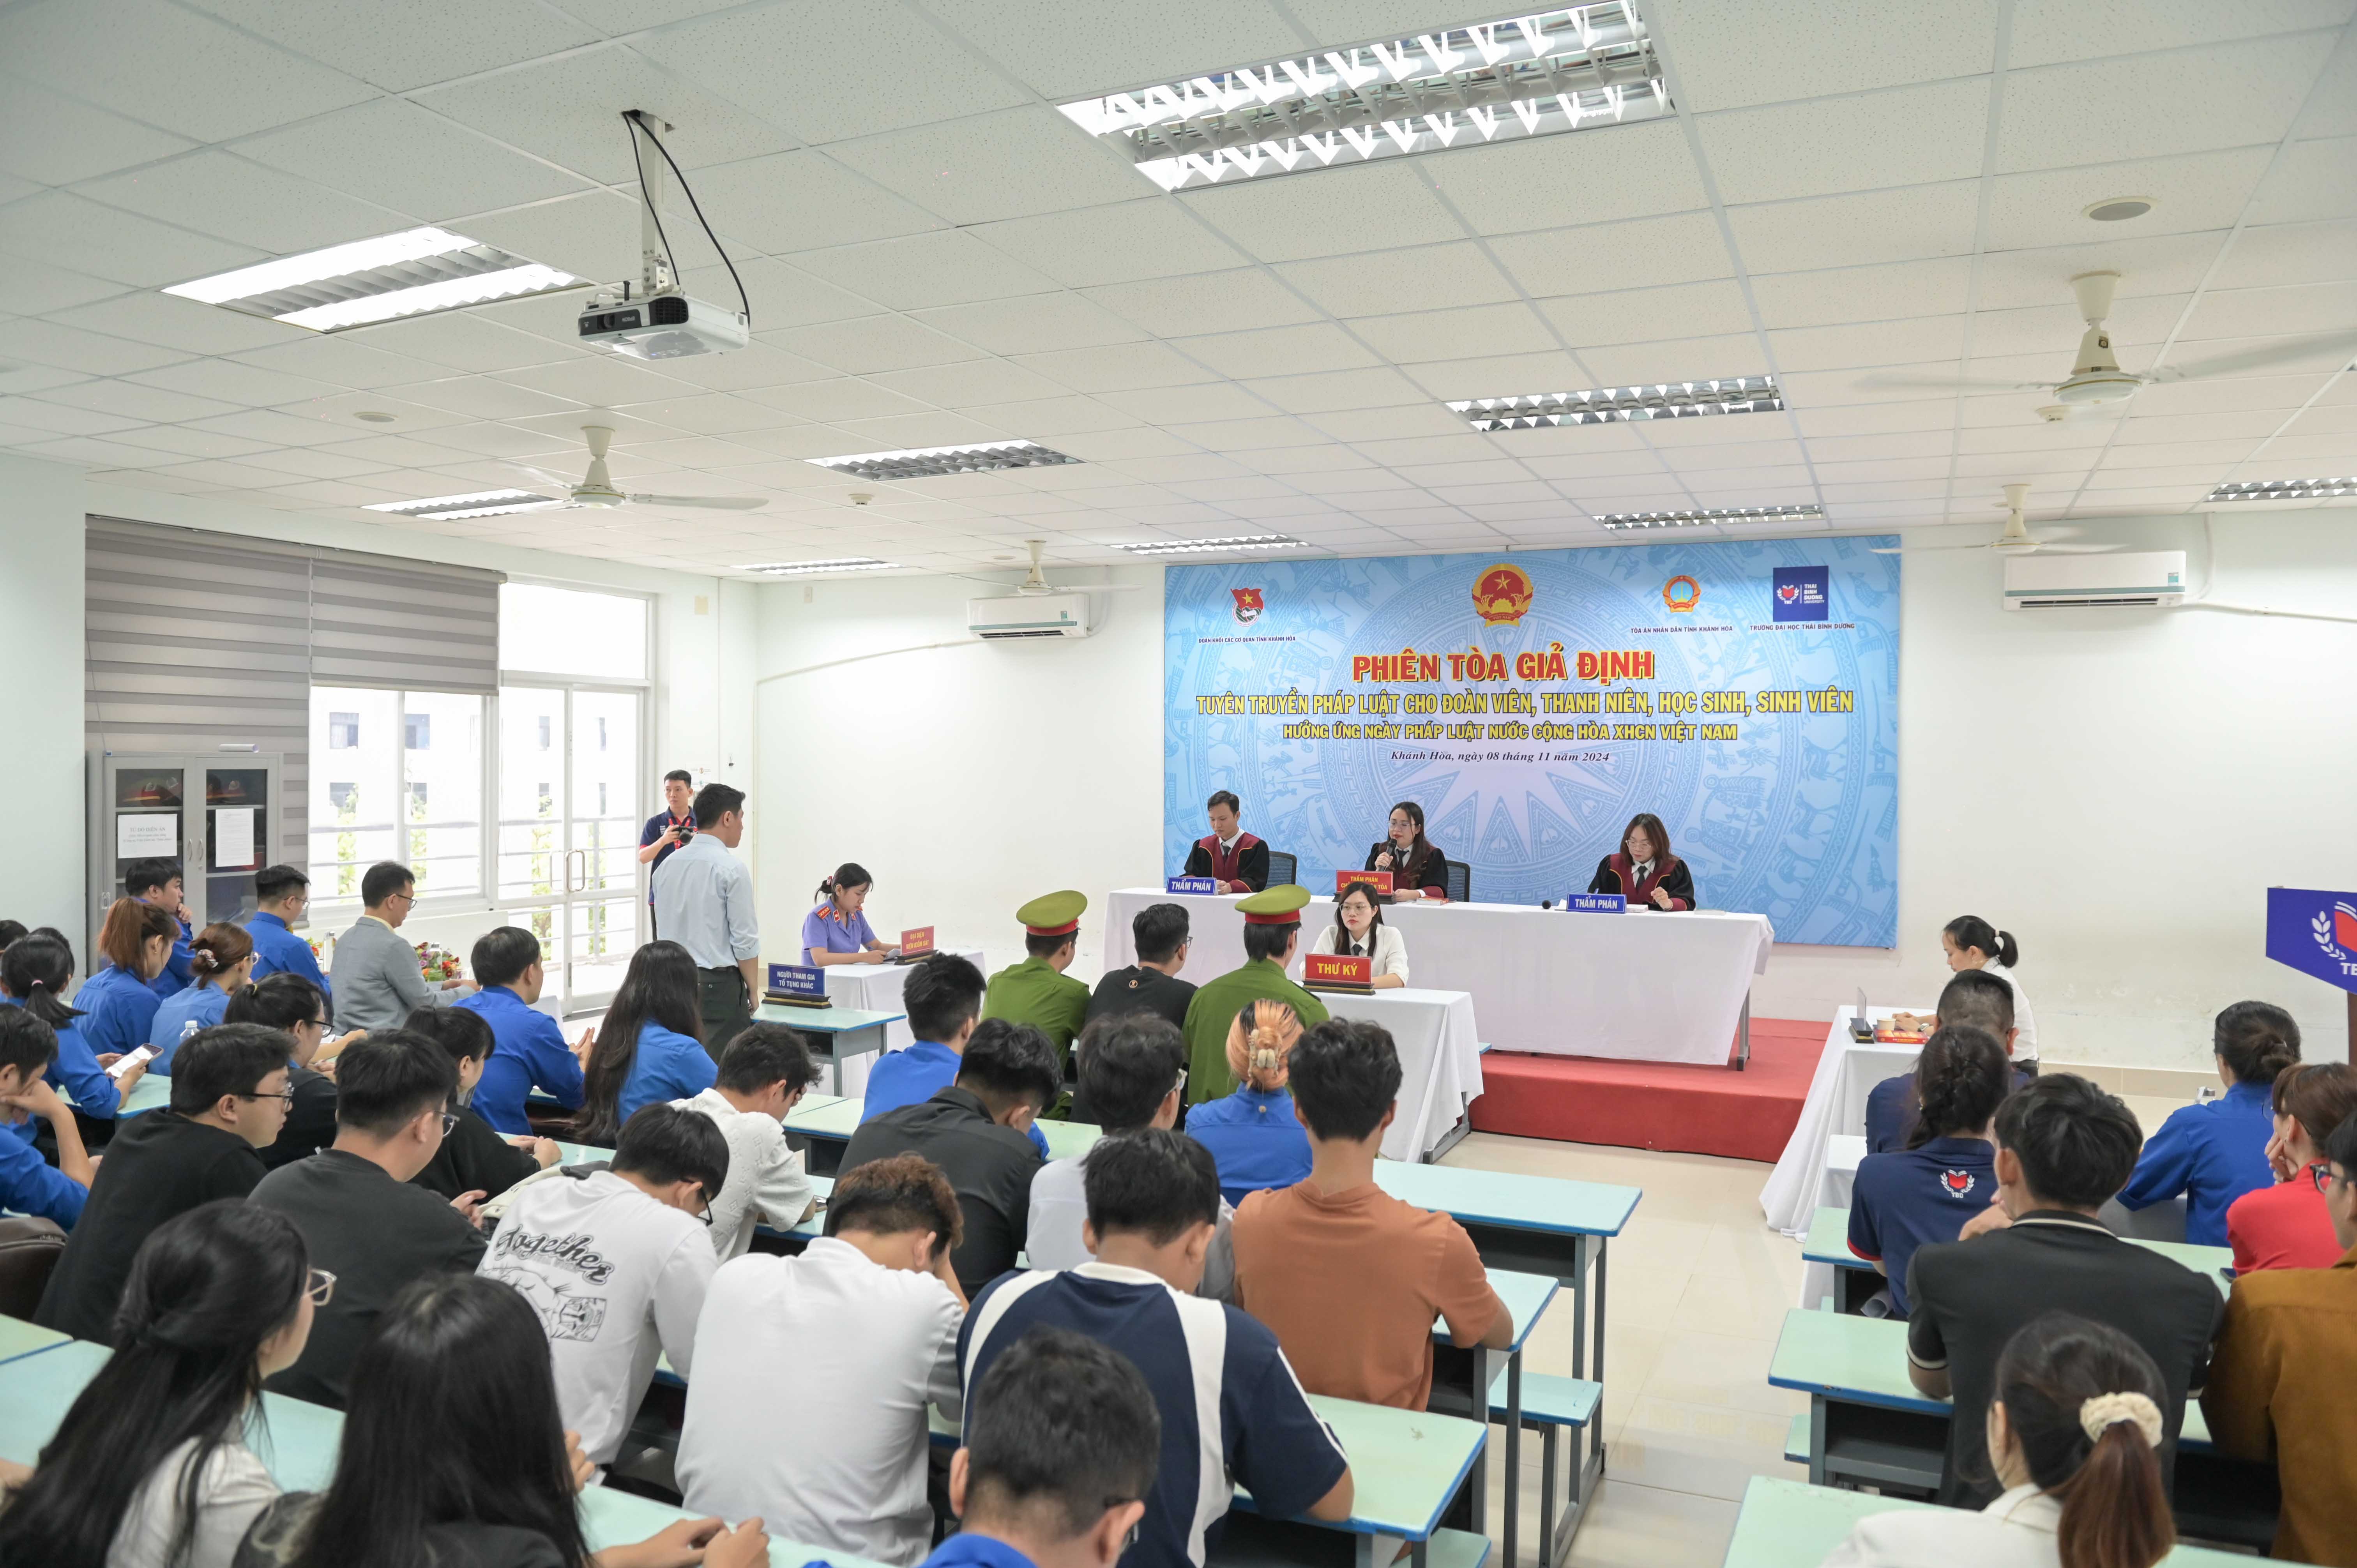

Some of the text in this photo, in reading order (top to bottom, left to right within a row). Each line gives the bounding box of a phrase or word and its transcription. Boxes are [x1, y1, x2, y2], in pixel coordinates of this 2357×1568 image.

[1353, 641, 1654, 685] PHIÊN TÒA GIẢ ĐỊNH
[1196, 685, 1853, 717] TUYÊN TRUYỀN PHÁP LUẬT CHO ĐOÀN VIÊN, THANH NIÊN, HỌC SINH, SINH VIÊN
[1283, 719, 1737, 743] HƯỞNG ỨNG NGÀY PHÁP LUẬT NƯỚC CỘNG HÒA XHCN VIỆT NAM
[1391, 751, 1610, 762] Khánh Hòa, ngày 08 tháng 11 năm 2024
[1171, 879, 1211, 891] THẨM PHÁN
[1575, 895, 1618, 909] THẨM PHÁN
[1317, 962, 1358, 976] THƯ KÝ
[779, 978, 786, 986] TỐ
[494, 1224, 614, 1285] Together
